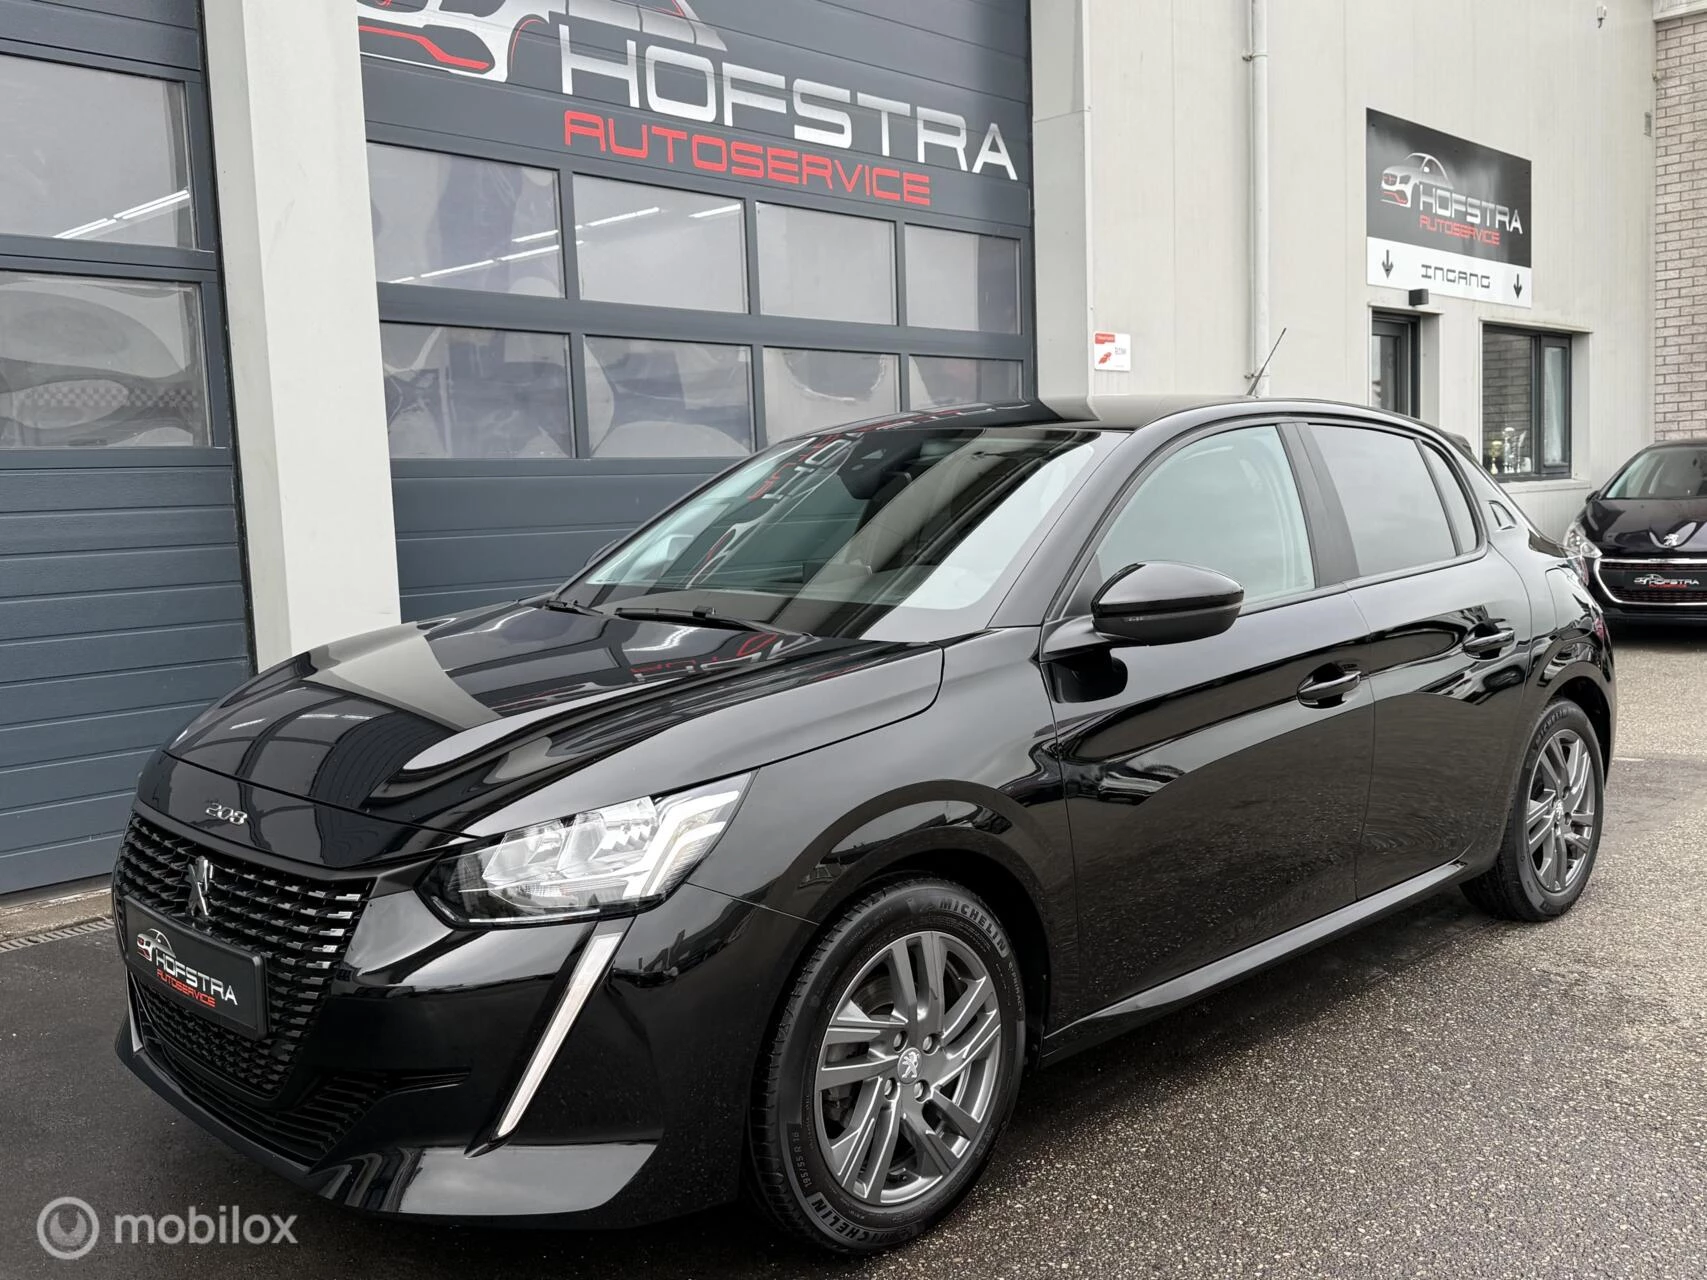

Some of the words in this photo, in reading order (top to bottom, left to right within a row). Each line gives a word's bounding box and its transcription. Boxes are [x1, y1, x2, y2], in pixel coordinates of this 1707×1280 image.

[559, 23, 1018, 181] HOFSTRA
[564, 110, 931, 206] AUTOSERVICE
[1419, 184, 1524, 235] HOFSTRA
[1419, 214, 1501, 246] AUTOSERVICE
[1421, 264, 1491, 289] INGANG
[205, 802, 248, 826] 208
[939, 898, 1007, 952] MICHELIN
[155, 948, 239, 1006] HOFSTRA
[156, 968, 216, 1009] AUTOSERVICE
